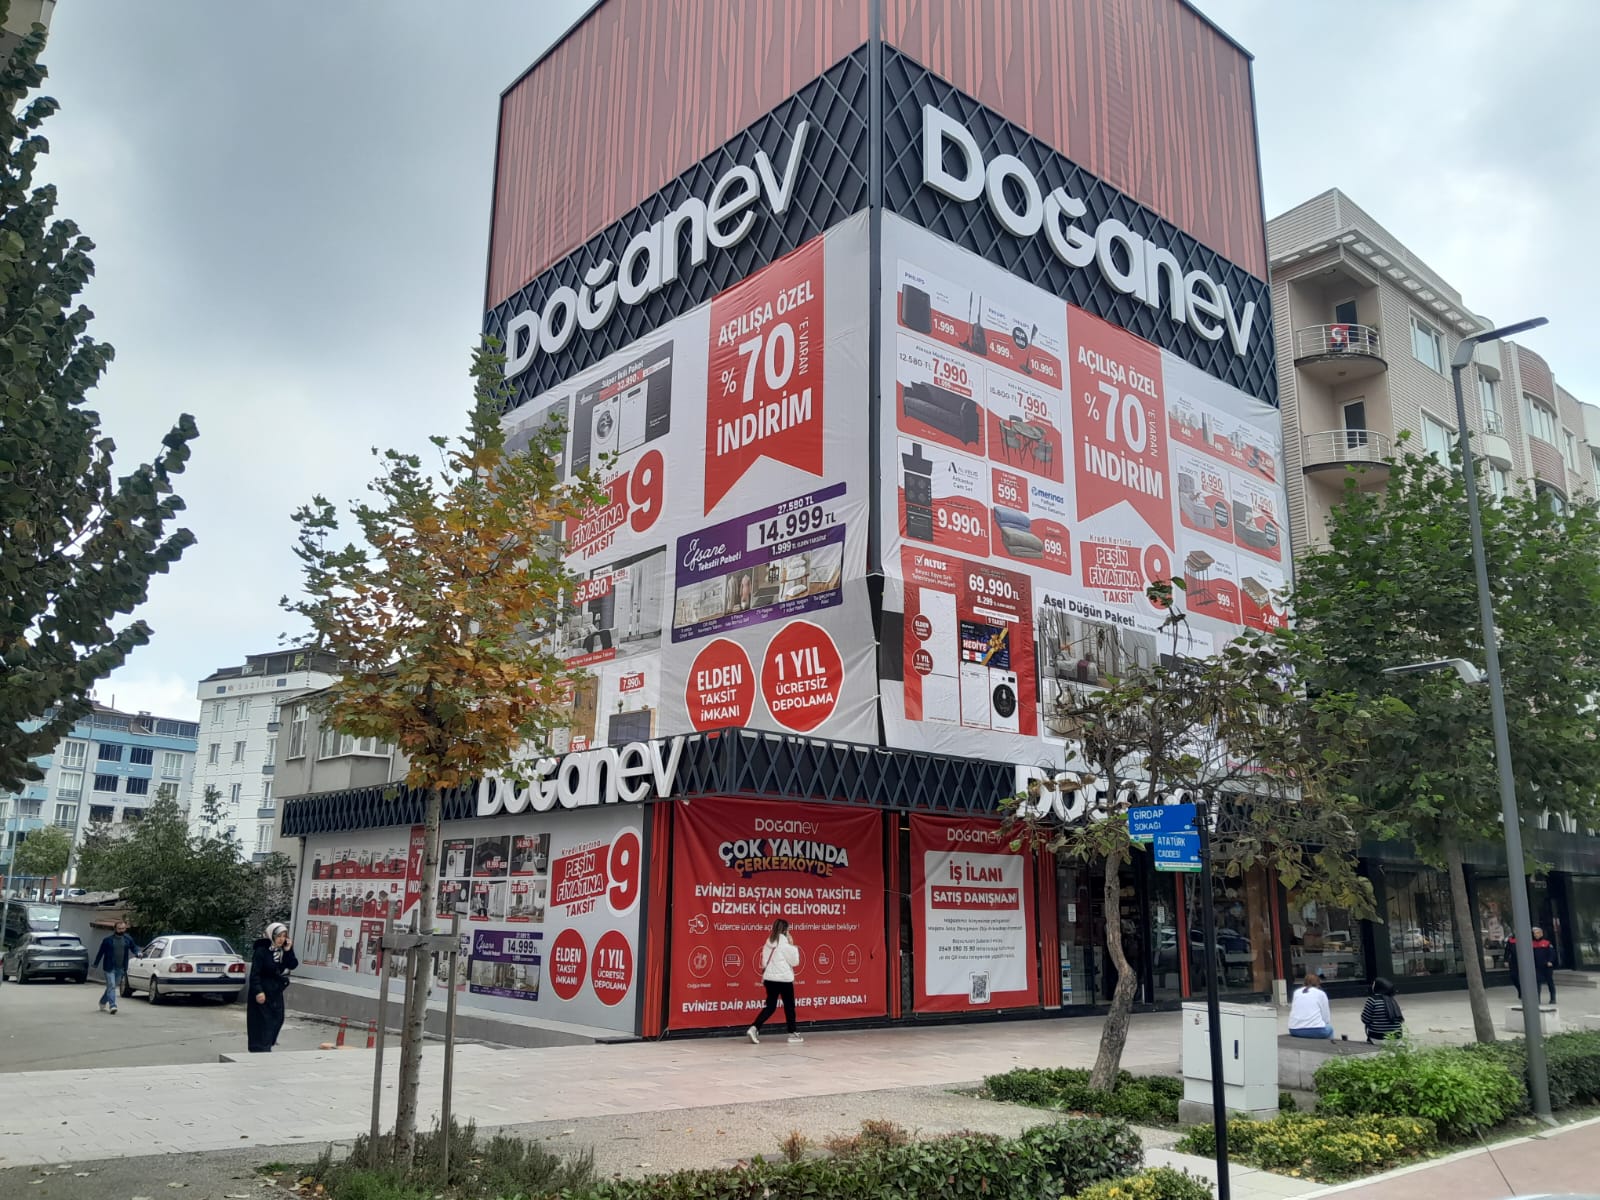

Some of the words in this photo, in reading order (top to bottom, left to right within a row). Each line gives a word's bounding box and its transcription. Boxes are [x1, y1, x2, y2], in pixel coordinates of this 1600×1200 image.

[718, 303, 773, 346] AÇILIŞA
[777, 280, 814, 315] ÖZEL
[933, 318, 955, 335] 1.999
[738, 322, 795, 404] 70
[799, 331, 809, 376] VARAN
[932, 358, 968, 385] 7.990
[1078, 345, 1126, 385] AÇILIŞA
[1129, 365, 1158, 398] ÖZEL
[1017, 392, 1047, 416] 7.990
[716, 387, 812, 457] İNDİRİM
[1098, 380, 1147, 453] 70
[1084, 436, 1163, 499] İNDİRİM
[631, 449, 664, 534] 9
[998, 484, 1017, 501] 599
[572, 502, 624, 549] FİYATINA
[759, 505, 823, 545] 14.999
[825, 512, 836, 525] TL
[937, 508, 980, 537] 9.990
[582, 530, 616, 560] TAKSİT
[683, 538, 726, 571] Efsane
[1044, 539, 1062, 555] 699
[924, 557, 946, 571] ALTUS
[1096, 546, 1129, 568] PEŞİN
[968, 573, 1012, 599] 69.990
[1012, 591, 1020, 601] TL
[1089, 565, 1141, 588] FİYATINA
[1103, 588, 1134, 603] TAKSİT
[1217, 593, 1231, 607] 999
[1043, 594, 1066, 609] Asel
[1068, 601, 1102, 619] Düğün
[1104, 610, 1135, 627] Paketi
[774, 653, 785, 681] 1
[790, 647, 826, 678] YIL
[697, 664, 742, 691] ELDEN
[776, 675, 828, 696] ÜCRETSİZ
[700, 688, 737, 706] TAKSİT
[772, 692, 834, 712] DEPOLAMA
[1133, 809, 1163, 820] GİRDAP
[1134, 821, 1161, 831] SOKAĞI
[718, 839, 763, 867] ÇOK
[768, 838, 849, 867] YAKINDA
[1158, 835, 1185, 847] ATATÜRK
[565, 852, 595, 878] PEŞİN
[609, 832, 640, 910] 9
[734, 855, 834, 877] ÇERKEZKÖY'DE
[949, 860, 962, 885] İŞ
[966, 861, 1003, 882] İLANI
[556, 873, 604, 902] FİYATINA
[695, 882, 736, 897] EVİNİZİ
[738, 887, 782, 901] BAŞTAN
[784, 888, 813, 899] SONA
[815, 885, 861, 900] TAKSİTLE
[933, 891, 961, 905] SATIŞ
[565, 895, 595, 917] TAKSİT
[711, 899, 756, 914] DİZMEK
[759, 900, 781, 918] İÇİN
[784, 900, 840, 915] GELİYORUZ
[508, 939, 533, 953] 14.999
[556, 948, 581, 964] ELDEN
[557, 964, 576, 974] TAKSİT
[608, 949, 625, 969] YIL
[594, 979, 626, 991] DEPOLAMA
[682, 1000, 718, 1013] EVİNİZE
[720, 997, 742, 1010] DAİR
[794, 999, 812, 1007] HER
[813, 997, 827, 1009] ŞEY
[829, 995, 862, 1006] BURADA
